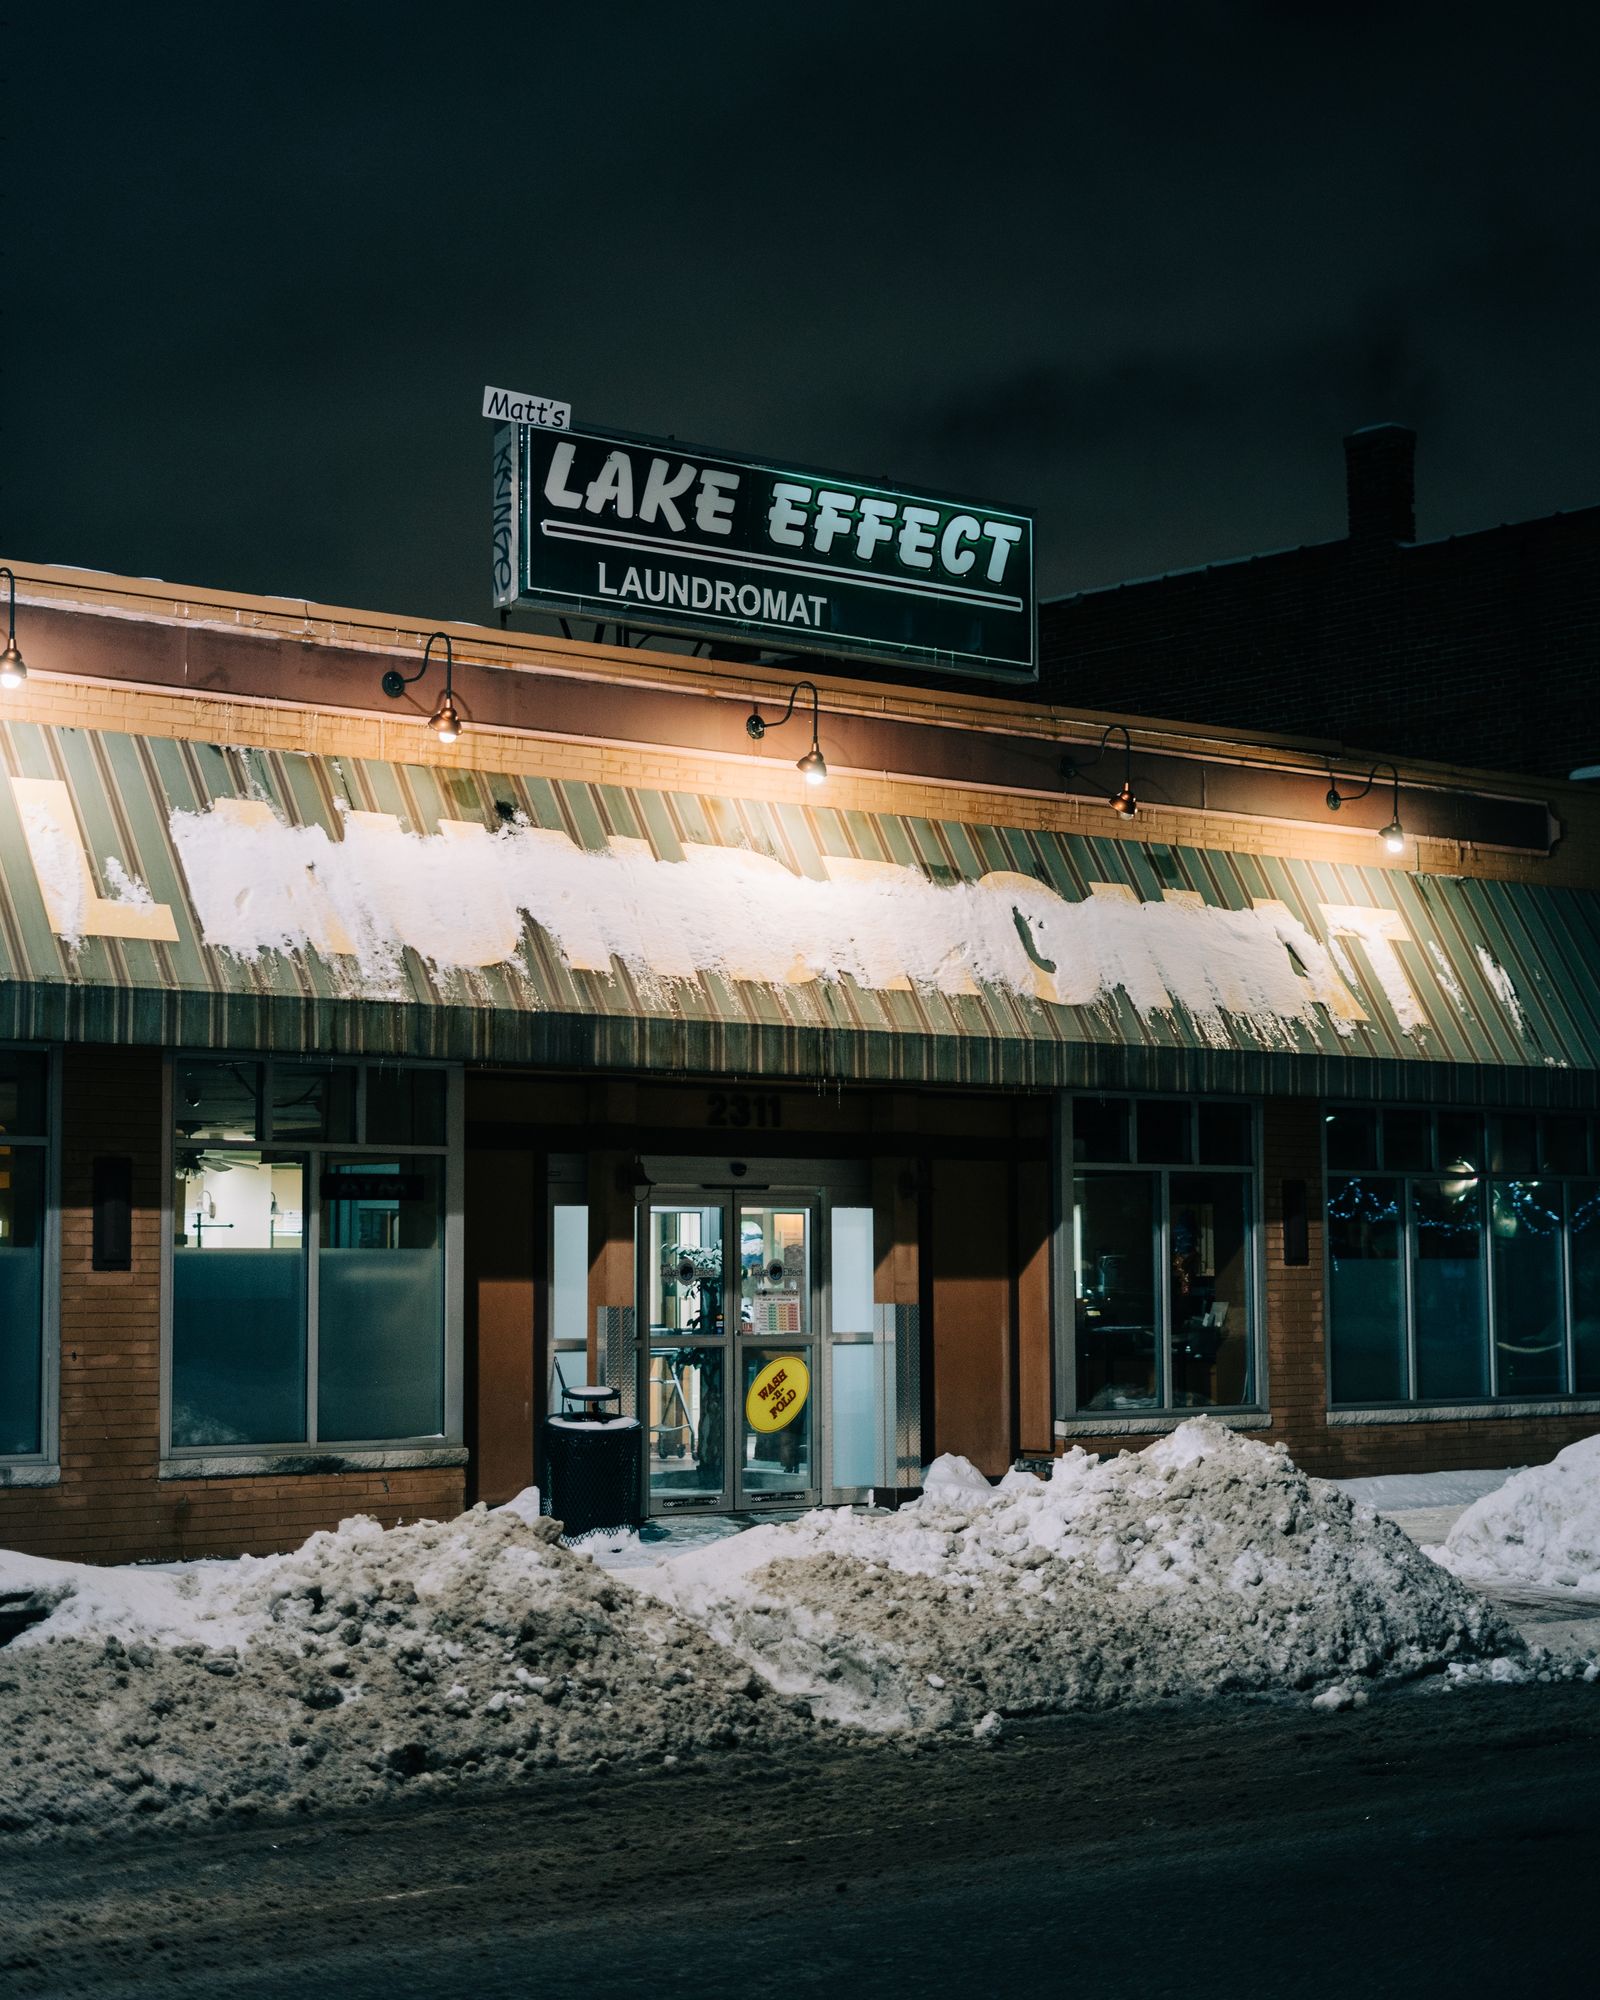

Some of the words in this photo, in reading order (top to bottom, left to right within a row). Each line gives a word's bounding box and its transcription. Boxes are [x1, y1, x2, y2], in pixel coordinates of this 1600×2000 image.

[487, 391, 565, 428] Matt's
[544, 441, 740, 535] LAKE
[768, 481, 1022, 584] EFFECT
[598, 562, 827, 628] LAUNDROMAT
[707, 1093, 781, 1128] 2311
[757, 1368, 788, 1401] WASH
[769, 1388, 797, 1420] FOLD
